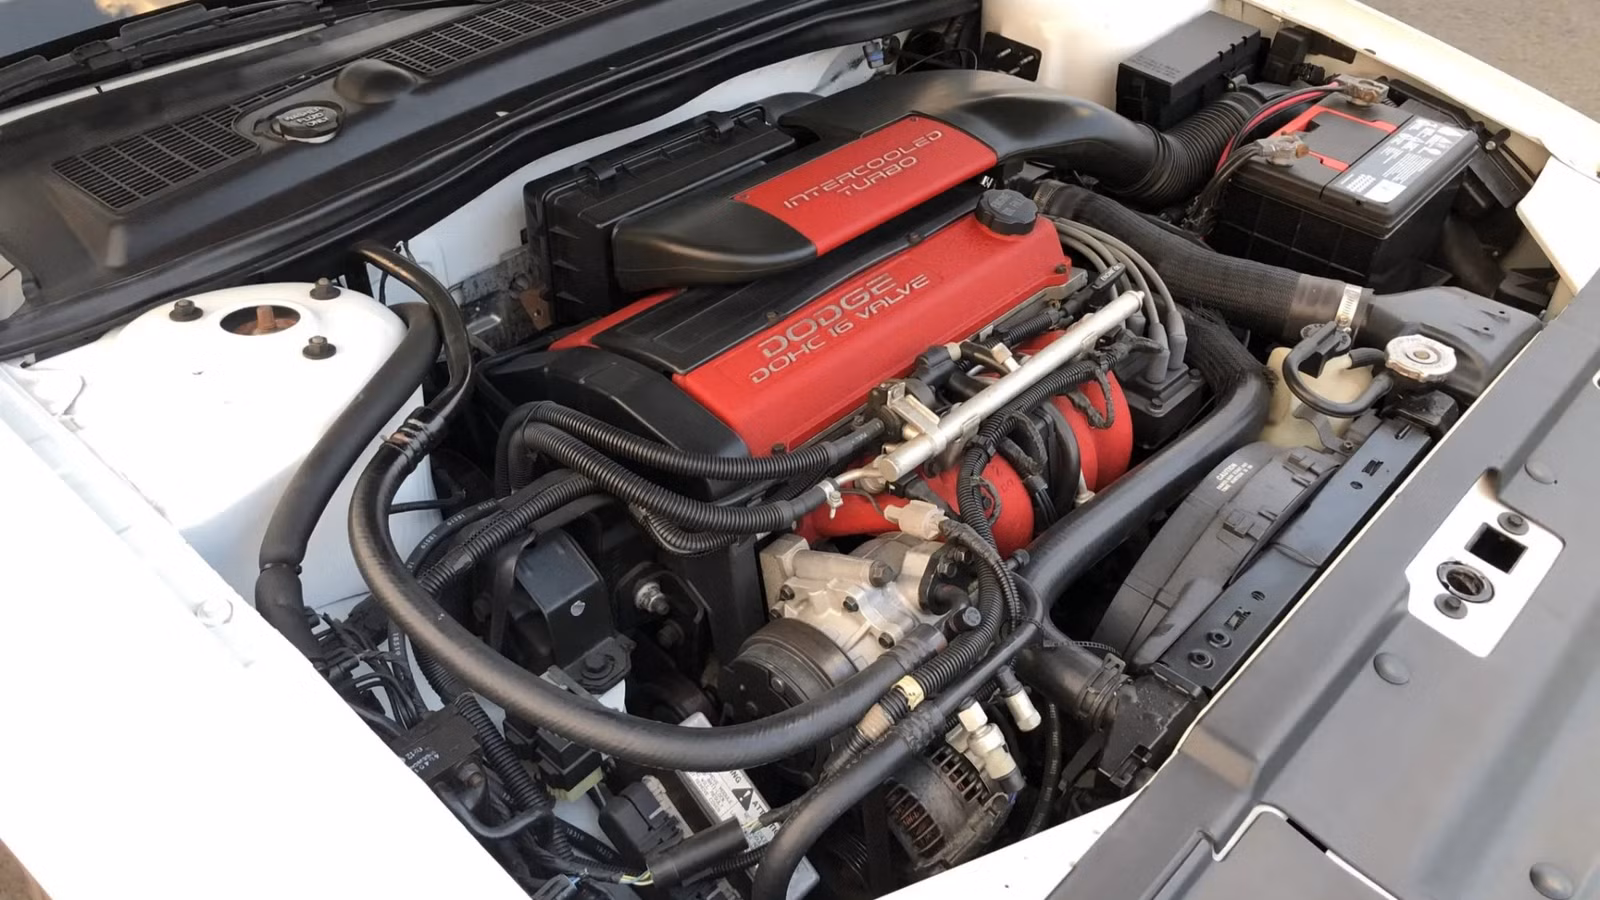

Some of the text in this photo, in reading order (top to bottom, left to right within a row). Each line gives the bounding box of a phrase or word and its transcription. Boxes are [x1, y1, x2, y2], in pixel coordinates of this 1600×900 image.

[297, 112, 324, 124] FLUID
[784, 130, 942, 209] INTERCOOLED
[836, 156, 918, 197] TURBO
[749, 274, 930, 384] DOHC 16 VALVE
[758, 273, 896, 358] DODGE
